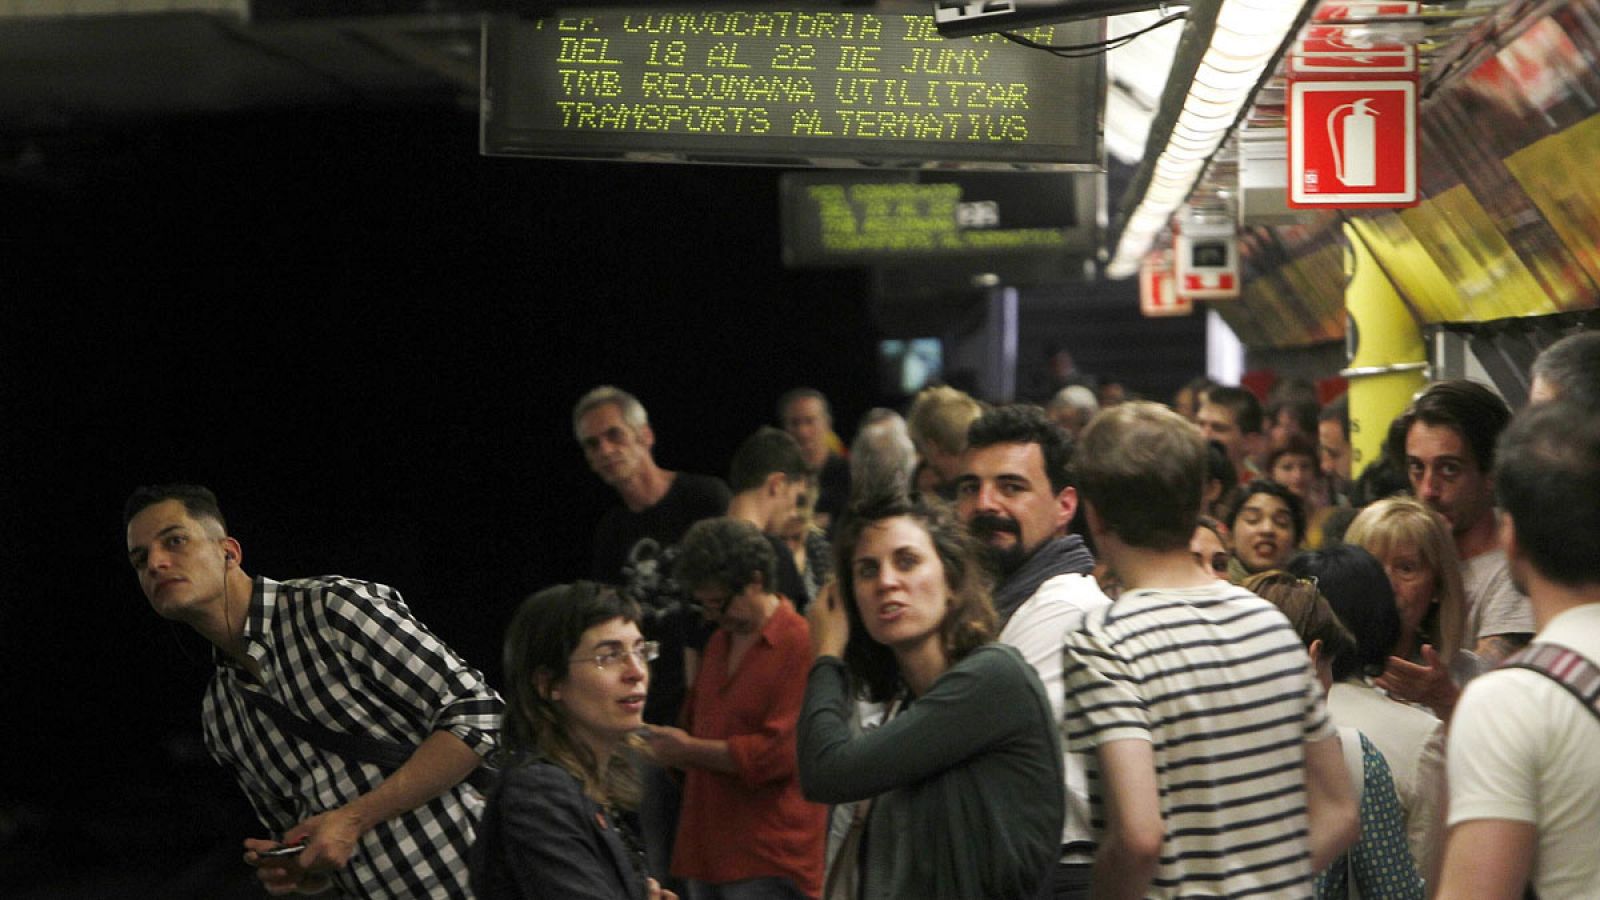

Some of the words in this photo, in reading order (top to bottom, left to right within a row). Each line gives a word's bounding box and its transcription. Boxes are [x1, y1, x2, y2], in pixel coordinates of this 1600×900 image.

[556, 36, 624, 65] DEL
[645, 39, 688, 67] 18
[707, 42, 752, 69] AL
[771, 43, 817, 70] 22
[836, 45, 882, 73] DE
[900, 47, 991, 76] JUNY
[558, 69, 623, 98] TMB
[642, 71, 817, 102] RECOMANA
[835, 77, 1031, 110] UTILITZAR
[556, 101, 771, 134] TRANSPORTS
[791, 107, 1030, 142] ALTERNATIUS
